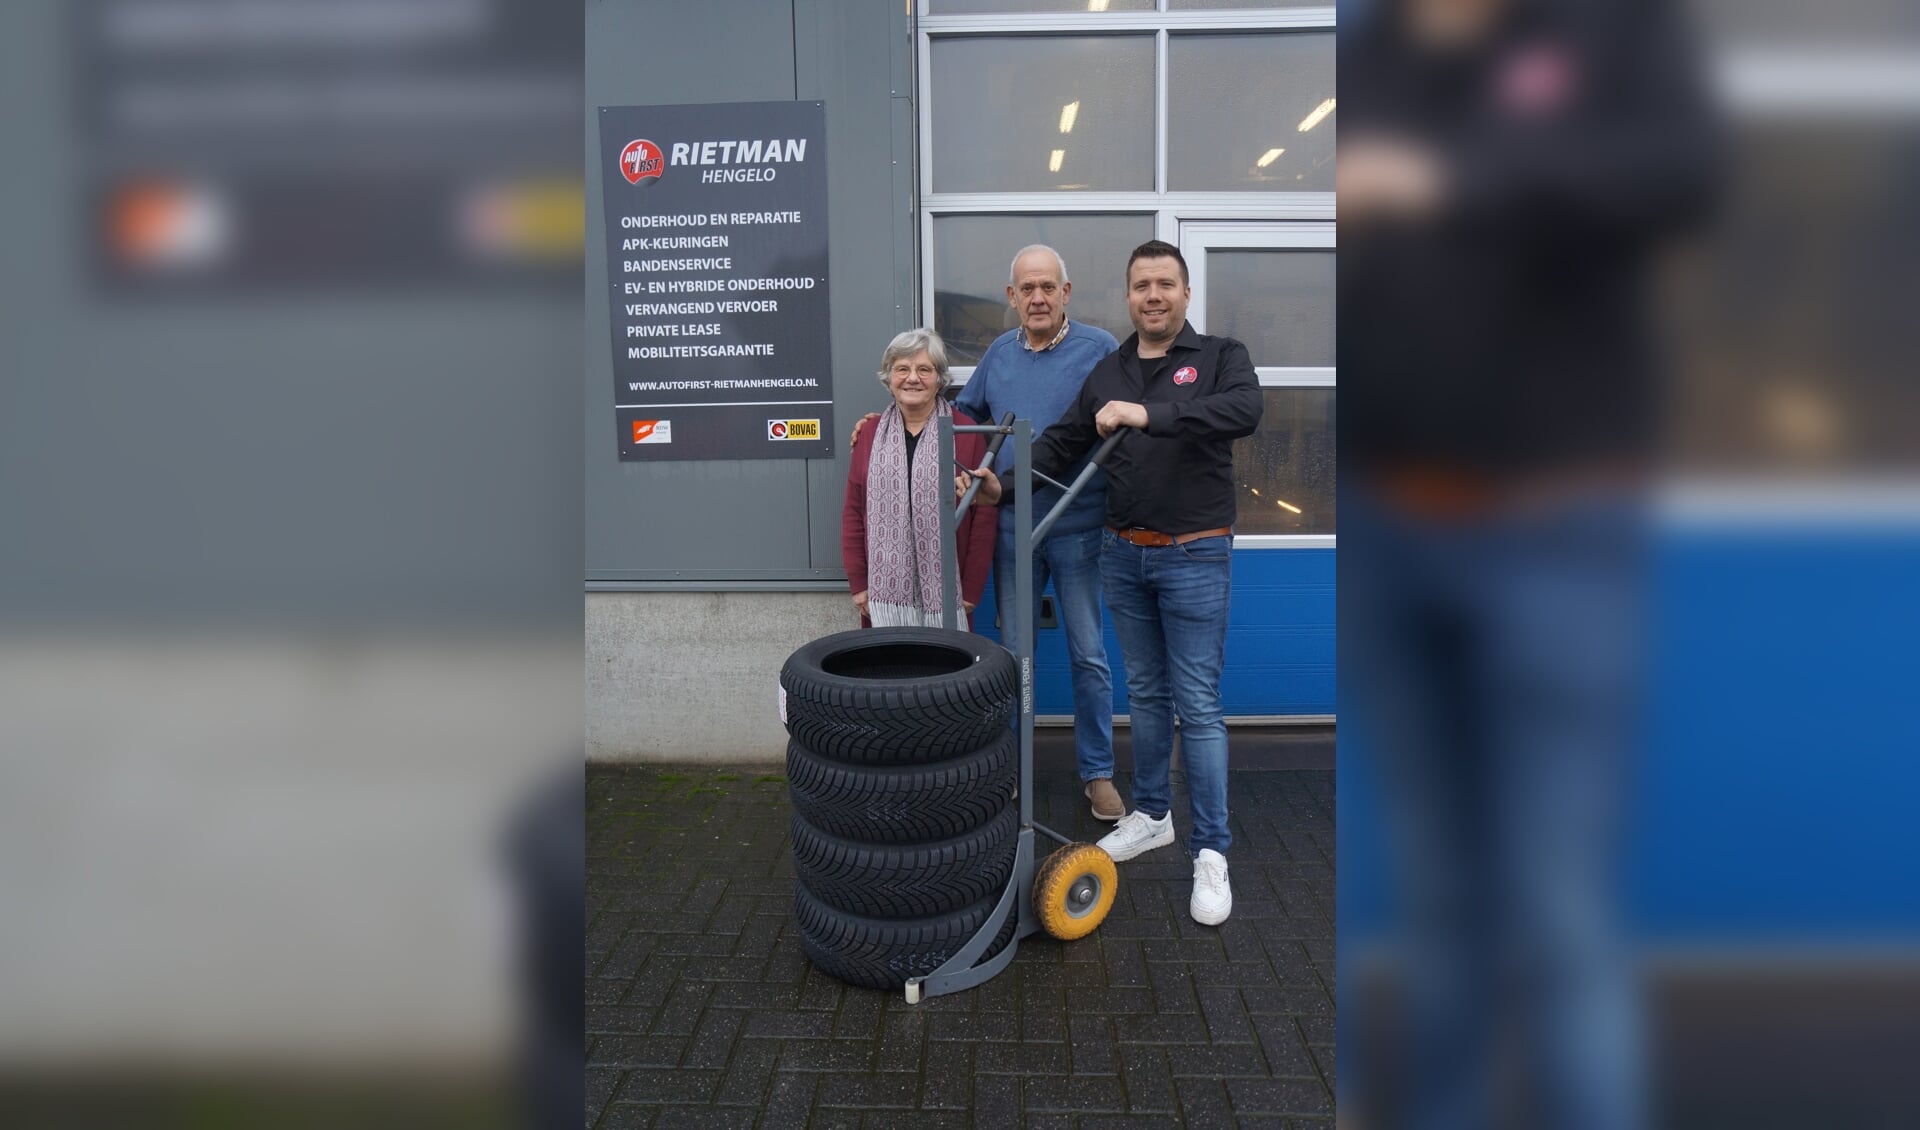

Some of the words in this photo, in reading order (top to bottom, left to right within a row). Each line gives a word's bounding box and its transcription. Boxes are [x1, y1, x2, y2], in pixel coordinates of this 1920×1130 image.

[670, 138, 807, 166] RIETMAN
[701, 167, 776, 184] HENGELO
[621, 213, 707, 228] ONDERHOUD
[710, 213, 728, 226] EN
[730, 211, 801, 225] REPARATIE
[622, 235, 729, 251] APK-KEURINGEN
[623, 257, 732, 272] BANDENSERVICE
[624, 282, 646, 294] EV-
[648, 281, 666, 293] EN
[668, 279, 725, 293] HYBRIDE
[727, 277, 815, 291] ONDERHOUD
[625, 302, 715, 316] VERVANGEND
[716, 300, 778, 313] VERVOER
[627, 324, 679, 338] PRIVATE
[681, 323, 721, 336] LEASE
[628, 344, 775, 359] MOBILITEITSGARANTIE
[629, 378, 819, 391] WWW.AUTOFIRST-RIETMANHENGELO.NL
[790, 423, 817, 436] BOVAG
[1022, 656, 1030, 685] PENDING
[1022, 686, 1031, 713] PATENTS
